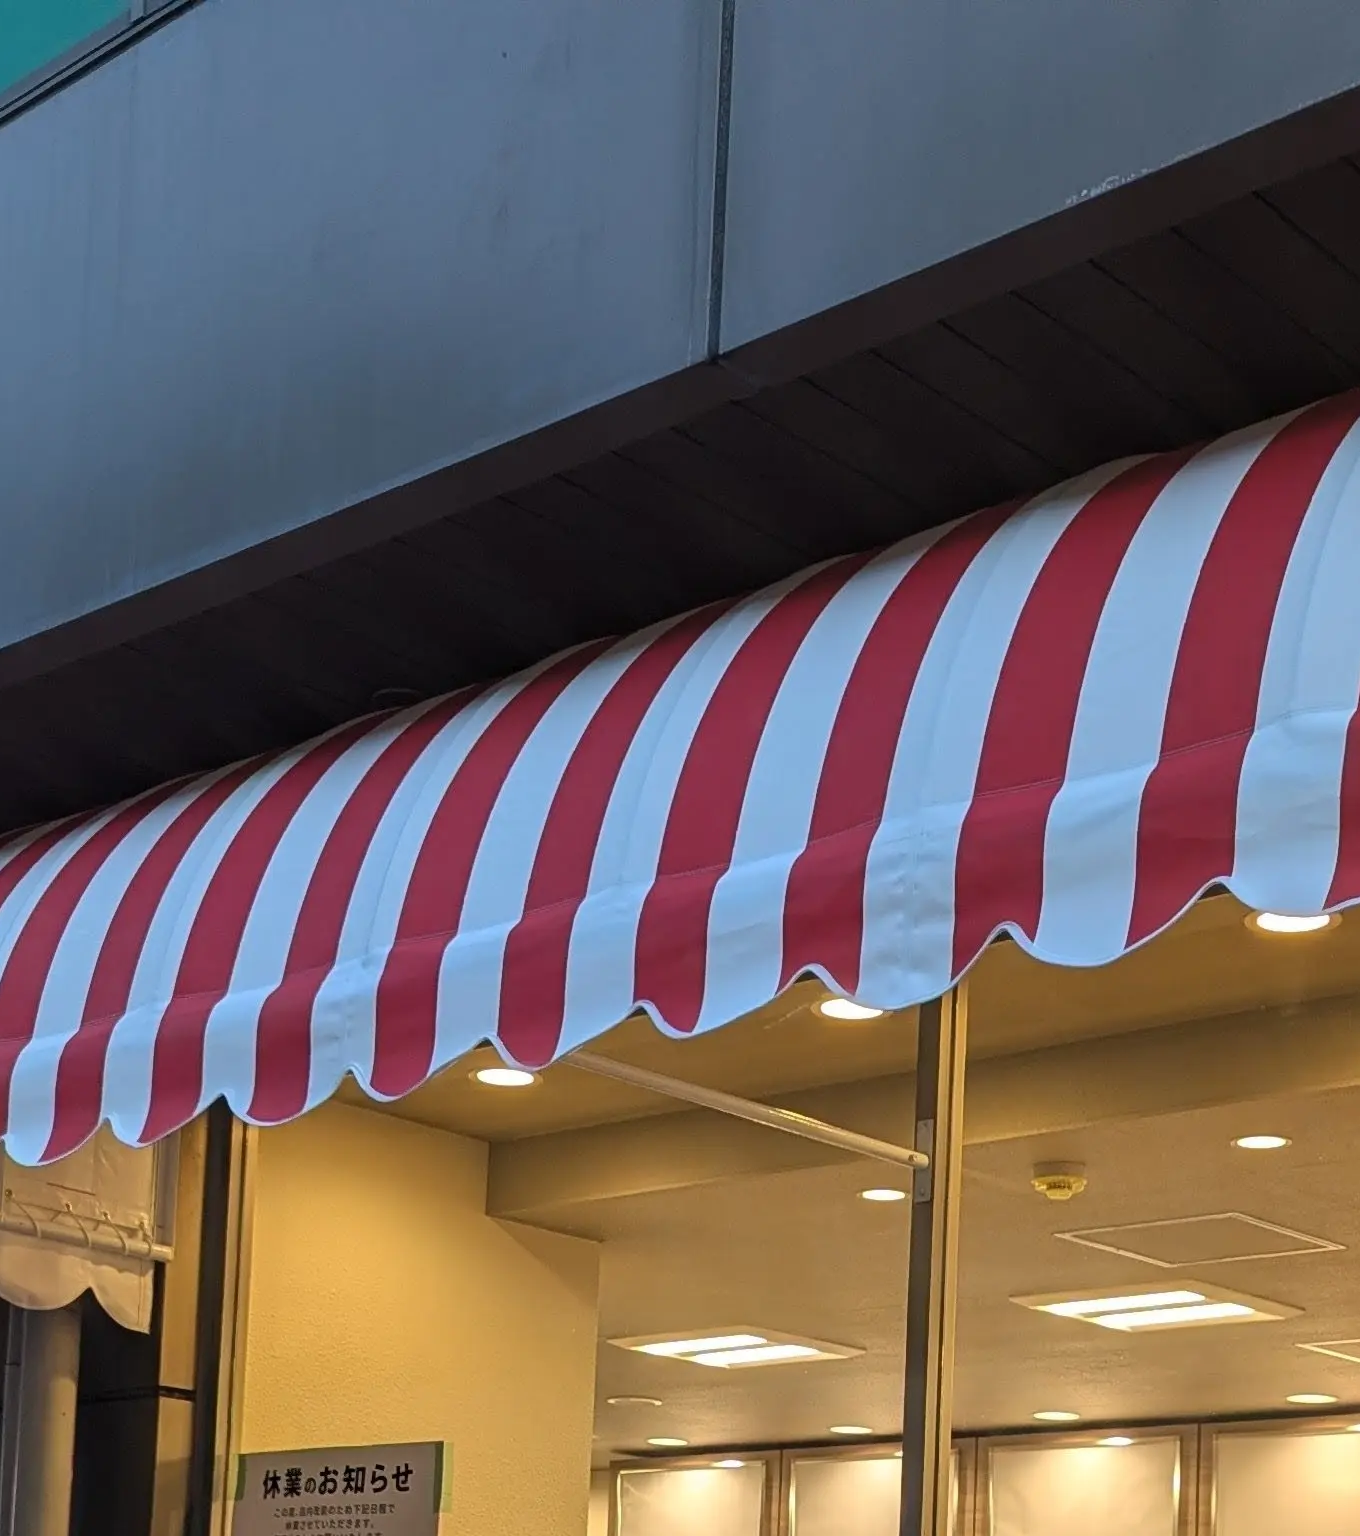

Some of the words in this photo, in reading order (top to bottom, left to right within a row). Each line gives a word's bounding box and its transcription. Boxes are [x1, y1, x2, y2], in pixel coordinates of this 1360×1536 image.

[263, 1463, 413, 1499] 休業のお知らせ
